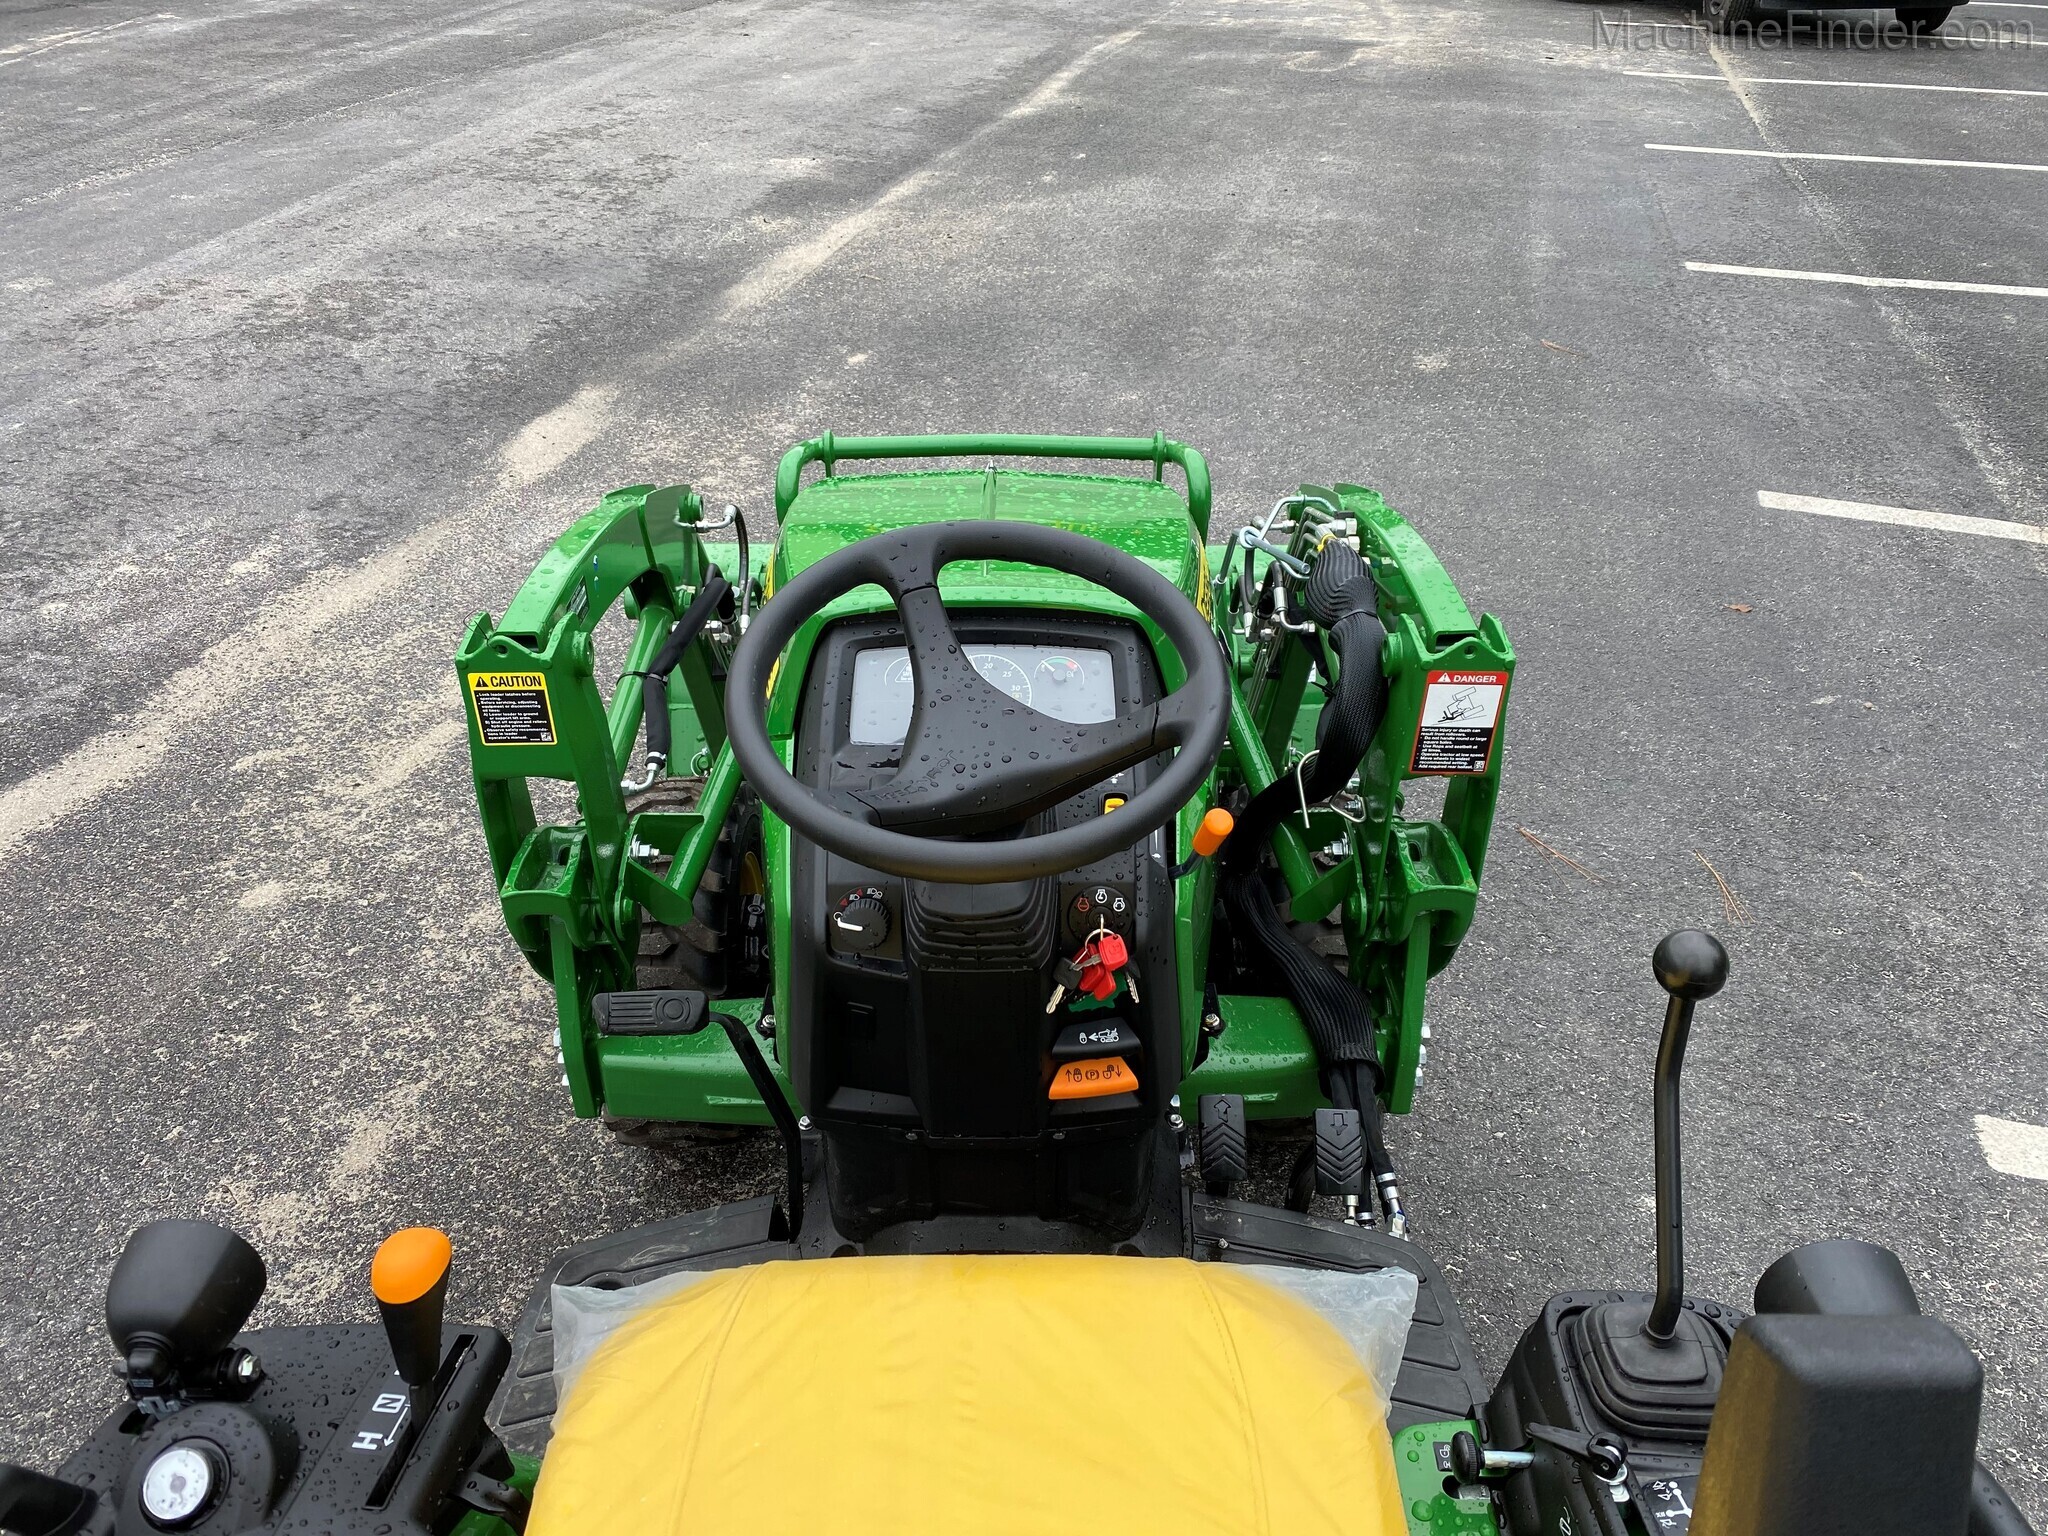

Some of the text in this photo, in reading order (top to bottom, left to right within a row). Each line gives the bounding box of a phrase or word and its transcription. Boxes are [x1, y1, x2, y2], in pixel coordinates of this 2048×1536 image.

[490, 676, 542, 687] CAUTION
[1453, 675, 1497, 683] DANGER
[375, 1395, 403, 1412] N
[351, 1431, 384, 1450] H
